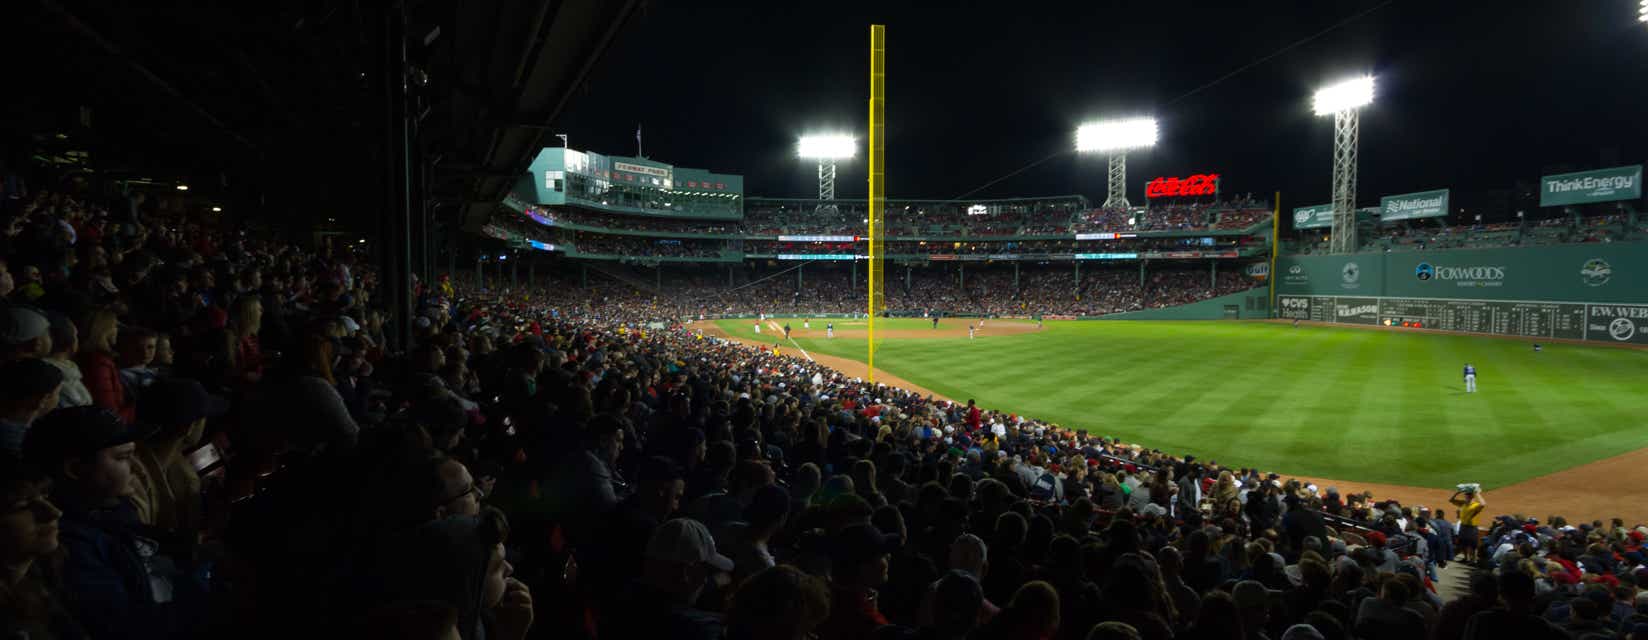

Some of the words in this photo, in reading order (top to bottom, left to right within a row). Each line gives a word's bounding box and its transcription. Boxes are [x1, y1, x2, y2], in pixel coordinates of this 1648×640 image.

[1547, 175, 1633, 193] ThinkEnergy
[1399, 196, 1442, 211] National
[1290, 298, 1308, 308] CVS
